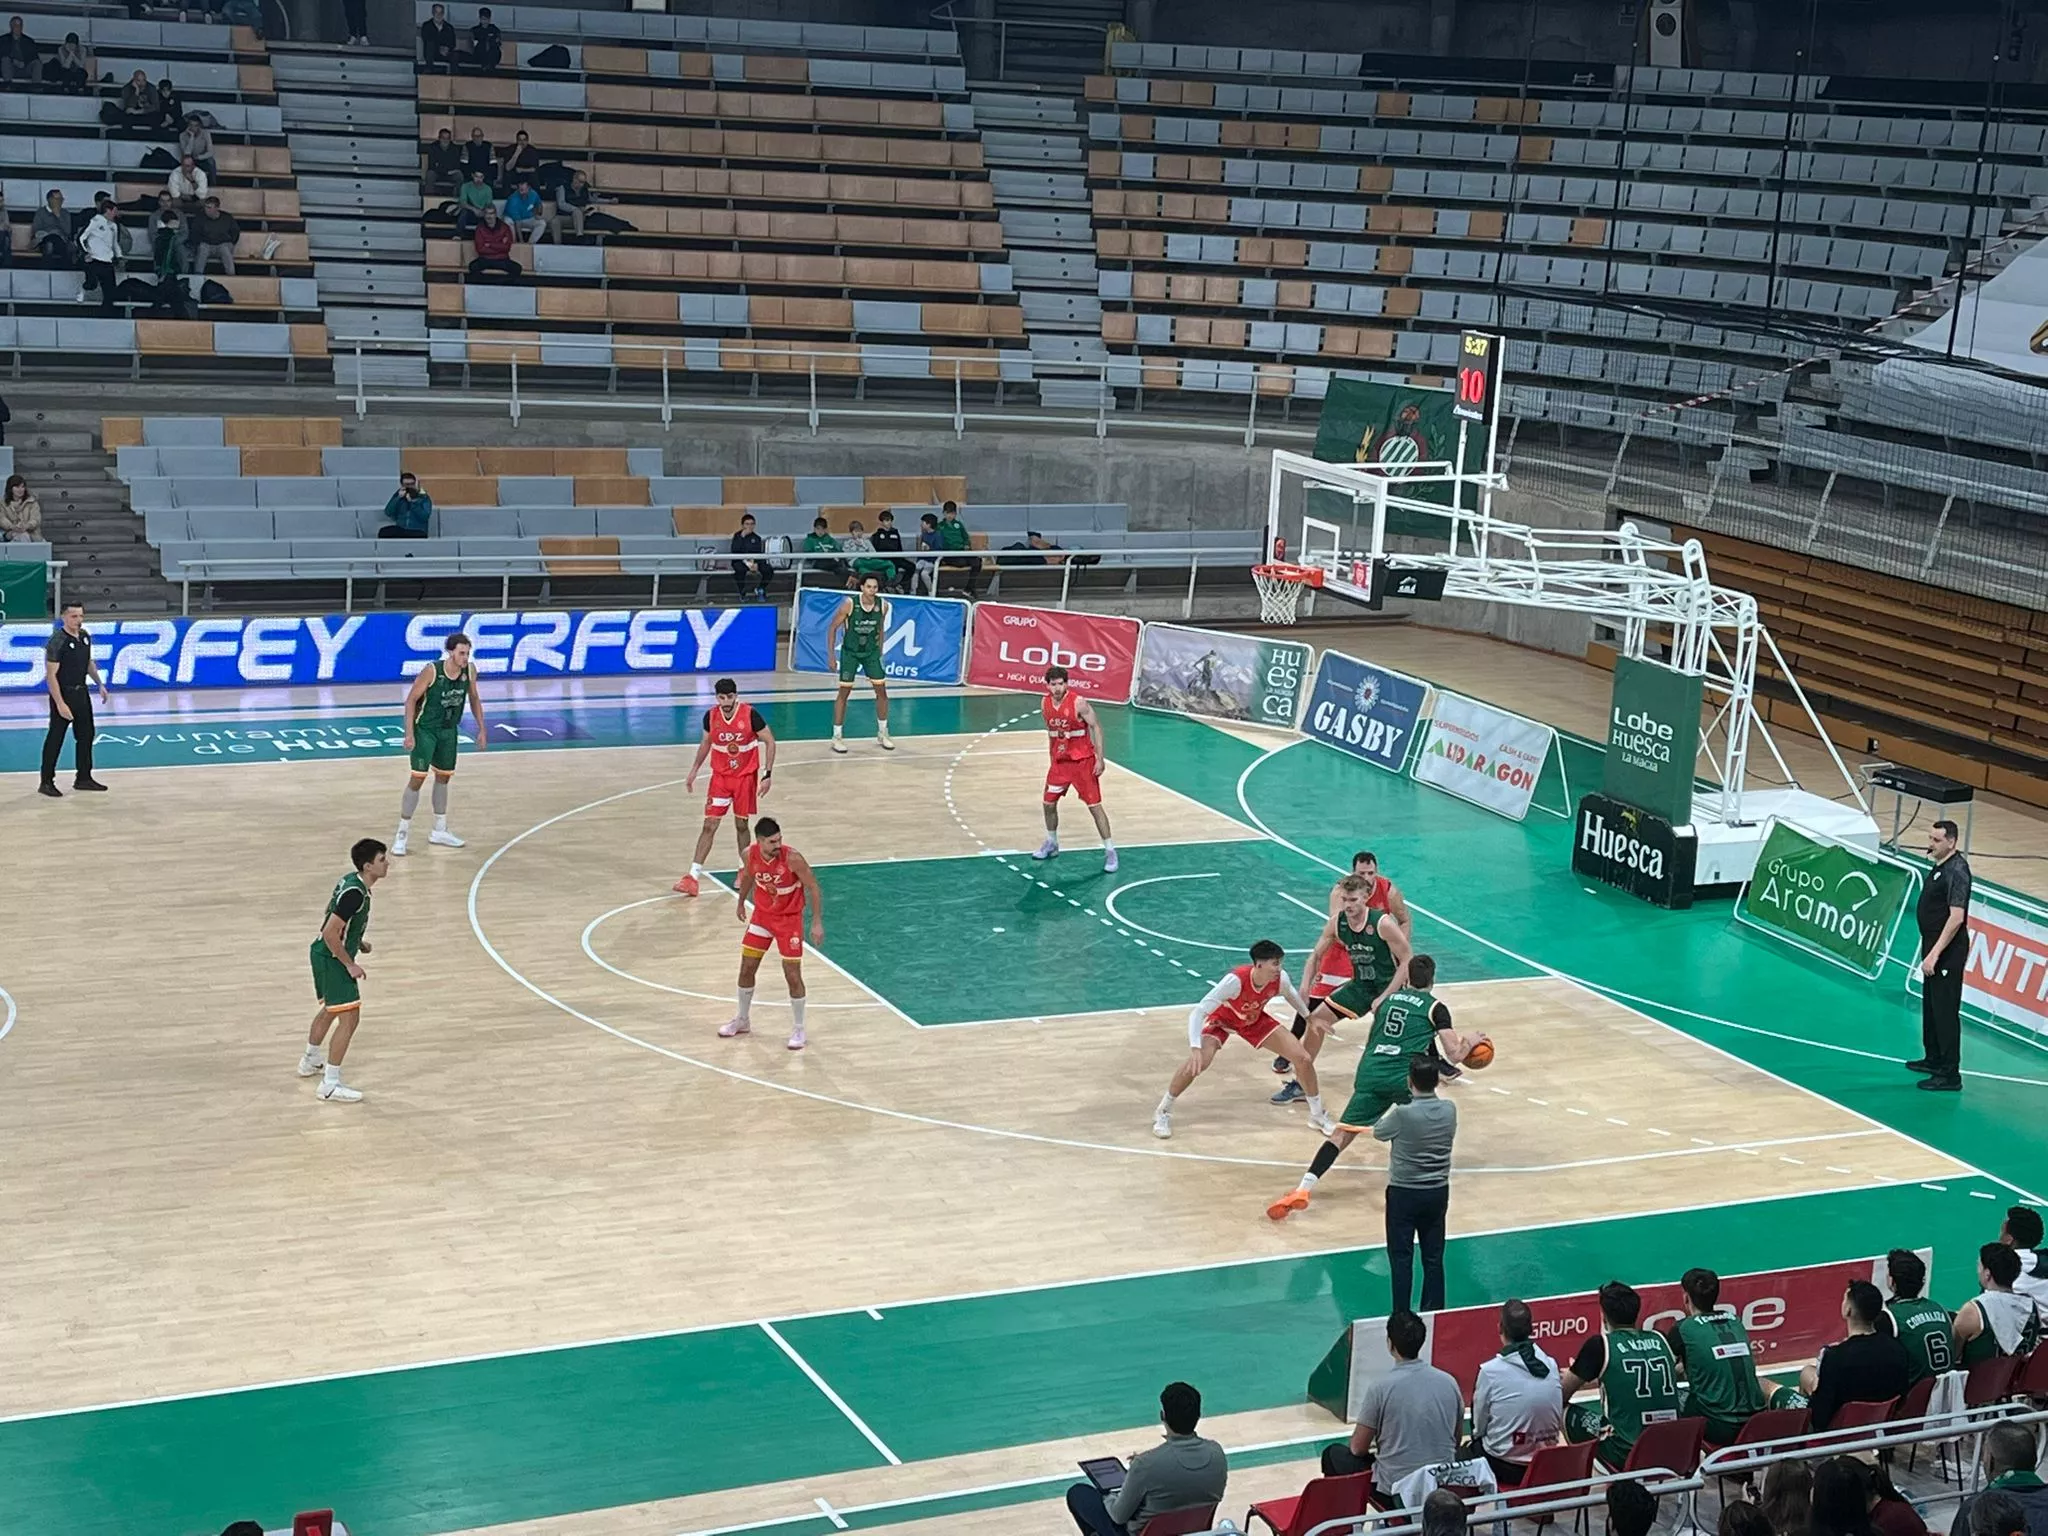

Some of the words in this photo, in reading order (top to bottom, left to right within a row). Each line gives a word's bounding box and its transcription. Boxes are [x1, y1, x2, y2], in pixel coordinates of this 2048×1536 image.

[1464, 335, 1488, 356] 5:37
[1460, 367, 1484, 404] 10
[1003, 615, 1038, 628] GRUPO
[400, 609, 742, 675] SERFEY
[1000, 641, 1106, 672] Lobe
[1267, 666, 1298, 689] es
[1262, 695, 1293, 717] ca
[1313, 701, 1404, 758] GASBY
[1613, 706, 1674, 741] Lobe
[192, 741, 257, 756] de
[1612, 728, 1671, 763] Huesca
[1580, 810, 1665, 880] Huesca
[754, 872, 783, 884] CBZ
[1768, 858, 1825, 892] Grupo
[1383, 1005, 1409, 1038] 5
[1528, 1316, 1589, 1339] GRUPO
[1924, 1330, 1951, 1371] 6
[1622, 1356, 1676, 1398] 77
